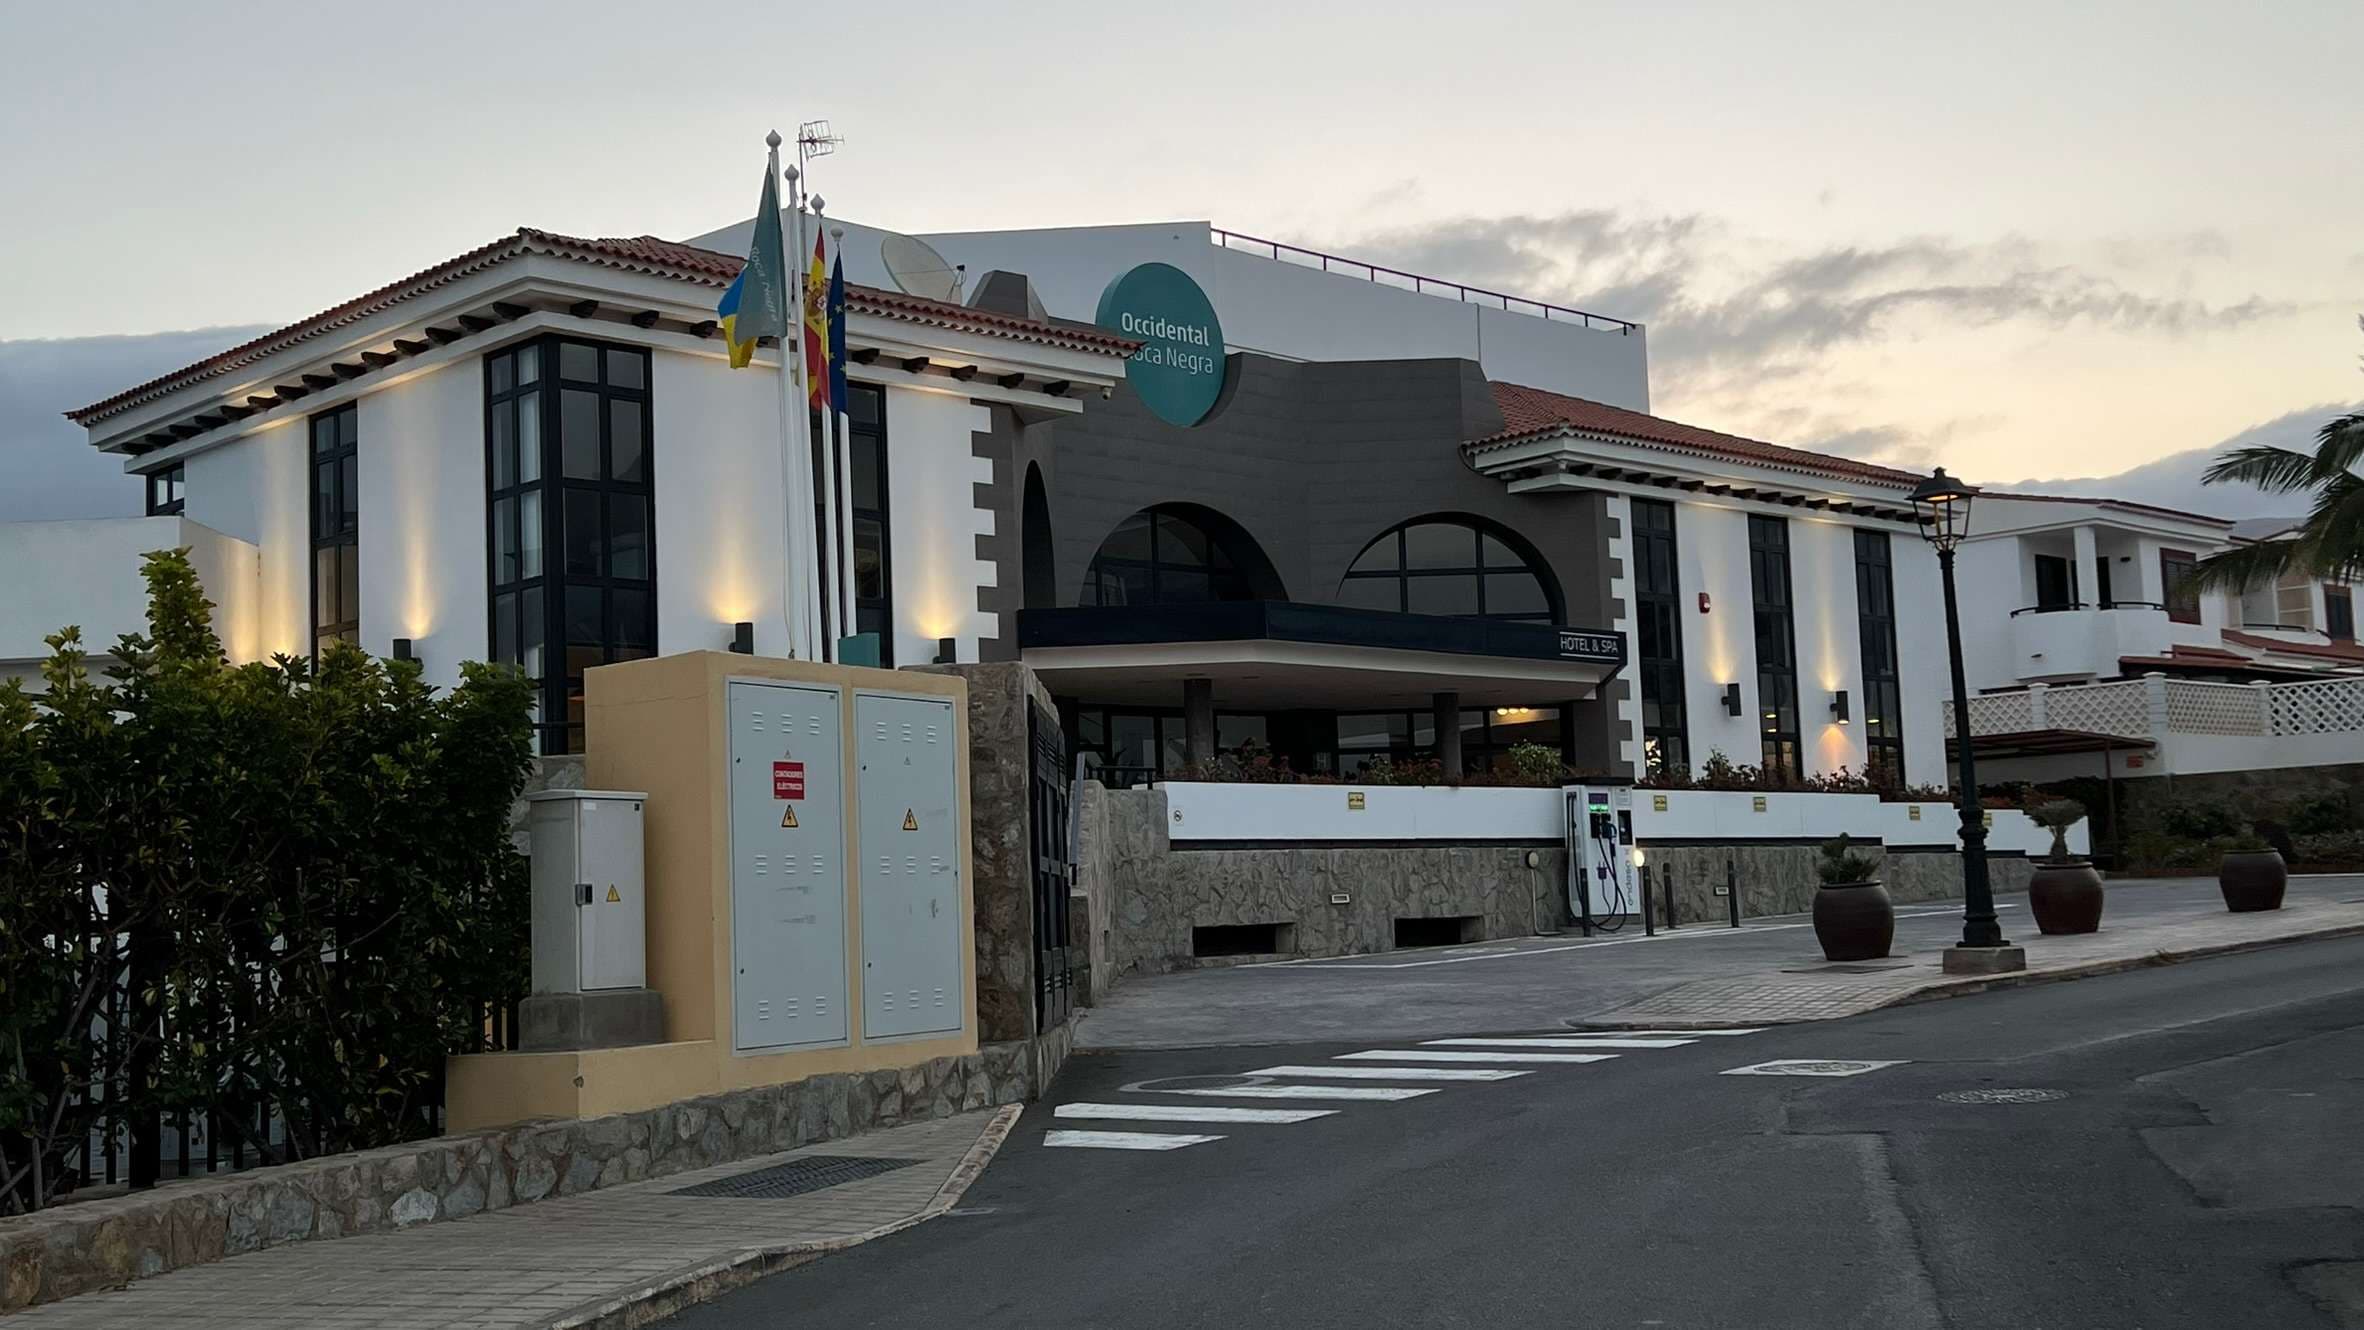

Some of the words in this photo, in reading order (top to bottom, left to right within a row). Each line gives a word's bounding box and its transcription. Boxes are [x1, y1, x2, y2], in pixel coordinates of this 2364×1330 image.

[1121, 312, 1210, 346] Occidental
[1130, 347, 1161, 365] oca
[1166, 346, 1213, 375] Negra
[1560, 636, 1590, 652] HOTEL
[1592, 639, 1599, 652] &
[1601, 640, 1618, 653] SPA
